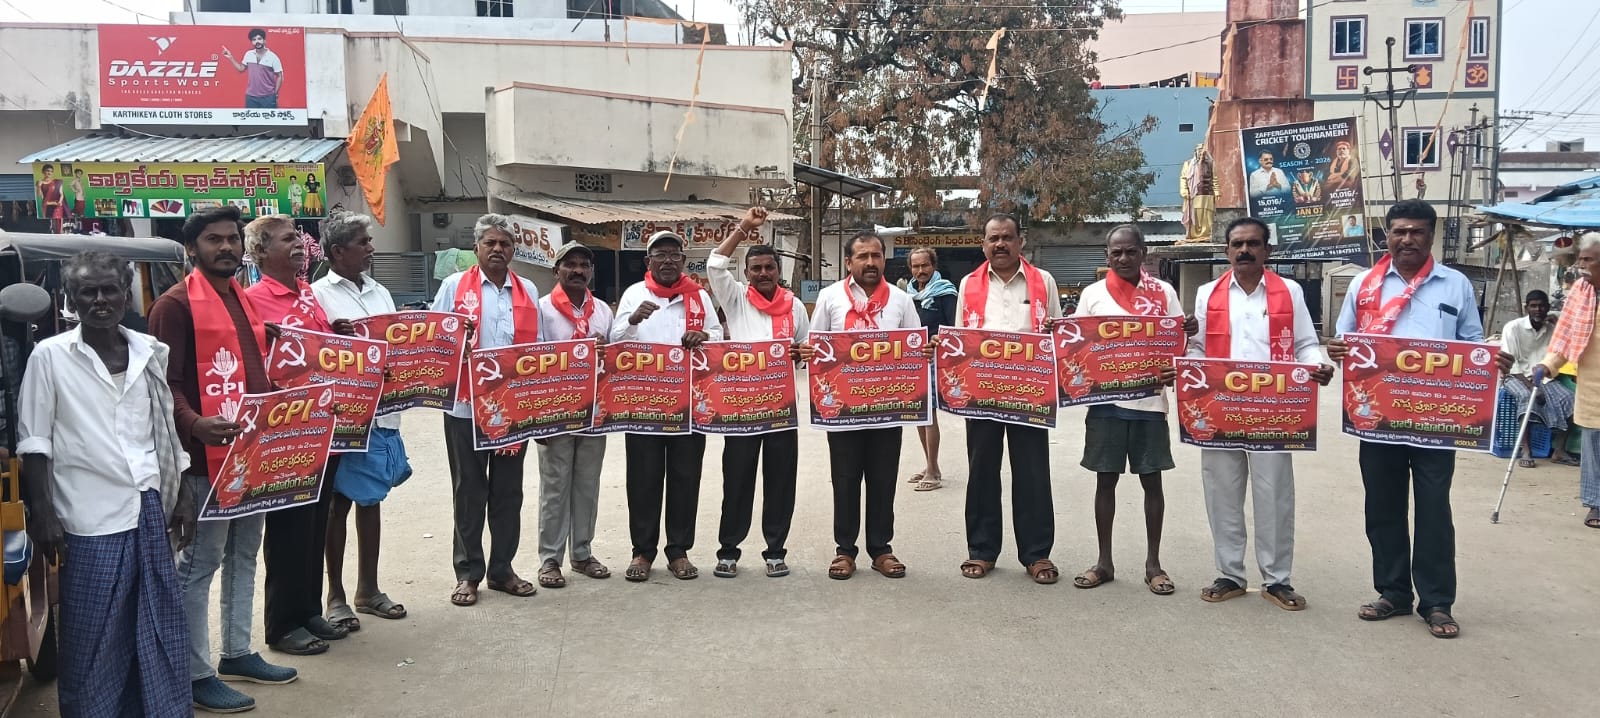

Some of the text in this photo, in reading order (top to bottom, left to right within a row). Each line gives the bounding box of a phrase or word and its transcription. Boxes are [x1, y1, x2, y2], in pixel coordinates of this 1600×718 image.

[108, 60, 218, 77] DAZZLE
[108, 78, 219, 87] Sports Wear
[185, 111, 212, 119] STORES
[1255, 128, 1298, 138] ZAFFERGADH
[1256, 129, 1348, 146] CRICKET TOURNAMENT
[88, 167, 178, 194] కార్తికేయ
[386, 322, 436, 344] CPI
[1098, 321, 1155, 339] CPI
[850, 340, 902, 362] CPI
[980, 339, 1033, 361] CPI
[319, 347, 363, 375] CPI
[516, 351, 568, 375] CPI
[616, 351, 664, 372] CPI
[723, 351, 766, 372] CPI
[1396, 349, 1463, 376] CPI
[205, 382, 244, 396] CPI
[850, 386, 867, 397] గొప్ప
[868, 386, 886, 396] ప్రజా
[1225, 371, 1285, 394] CPI
[268, 399, 315, 427] CPI
[1392, 399, 1476, 418] గొప్ప ప్రజా ప్రదర్శన
[1225, 414, 1245, 424] గొప్ప
[1246, 416, 1266, 425] ప్రజా
[1390, 418, 1483, 435] భారీ బహిరంగ సభ
